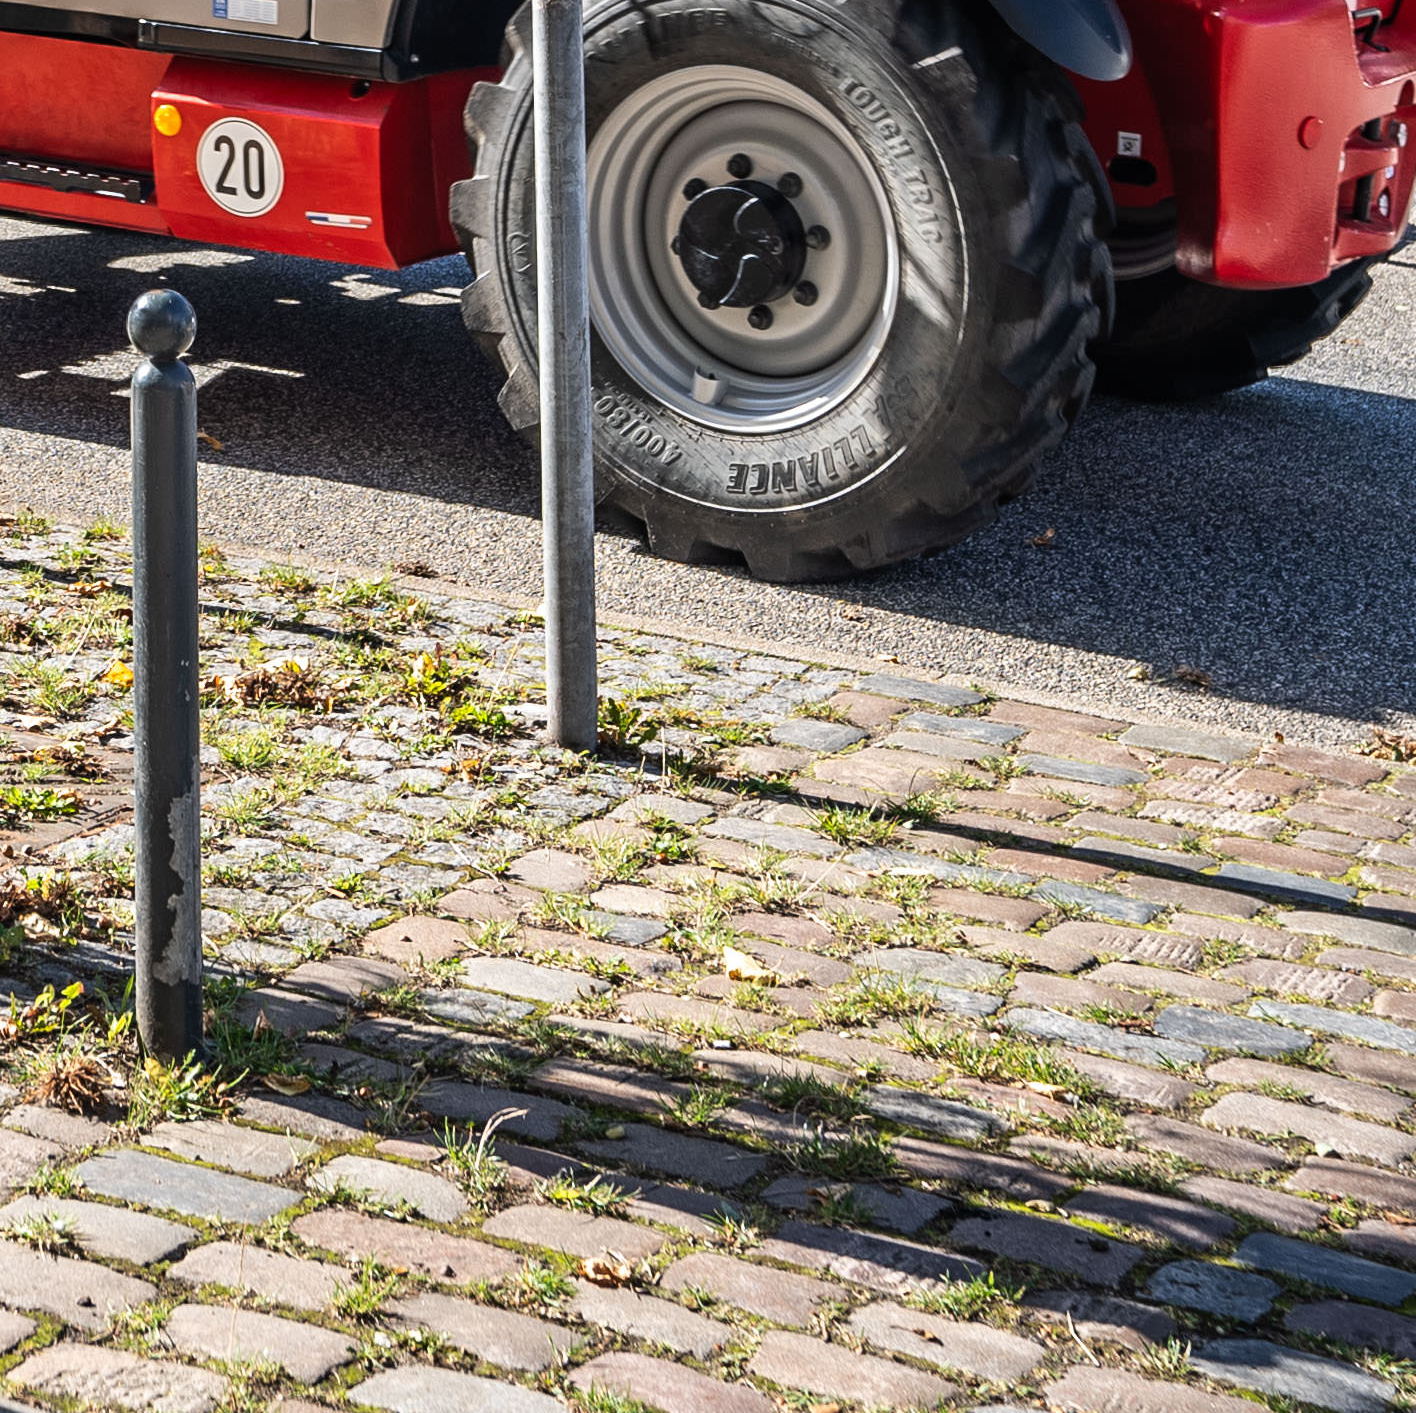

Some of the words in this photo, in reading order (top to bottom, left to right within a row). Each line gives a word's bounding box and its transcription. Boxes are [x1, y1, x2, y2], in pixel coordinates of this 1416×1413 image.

[214, 134, 266, 200] 20
[838, 74, 915, 161] TOUGH
[905, 169, 945, 245] TRAC
[726, 394, 896, 496] ALLIANCE
